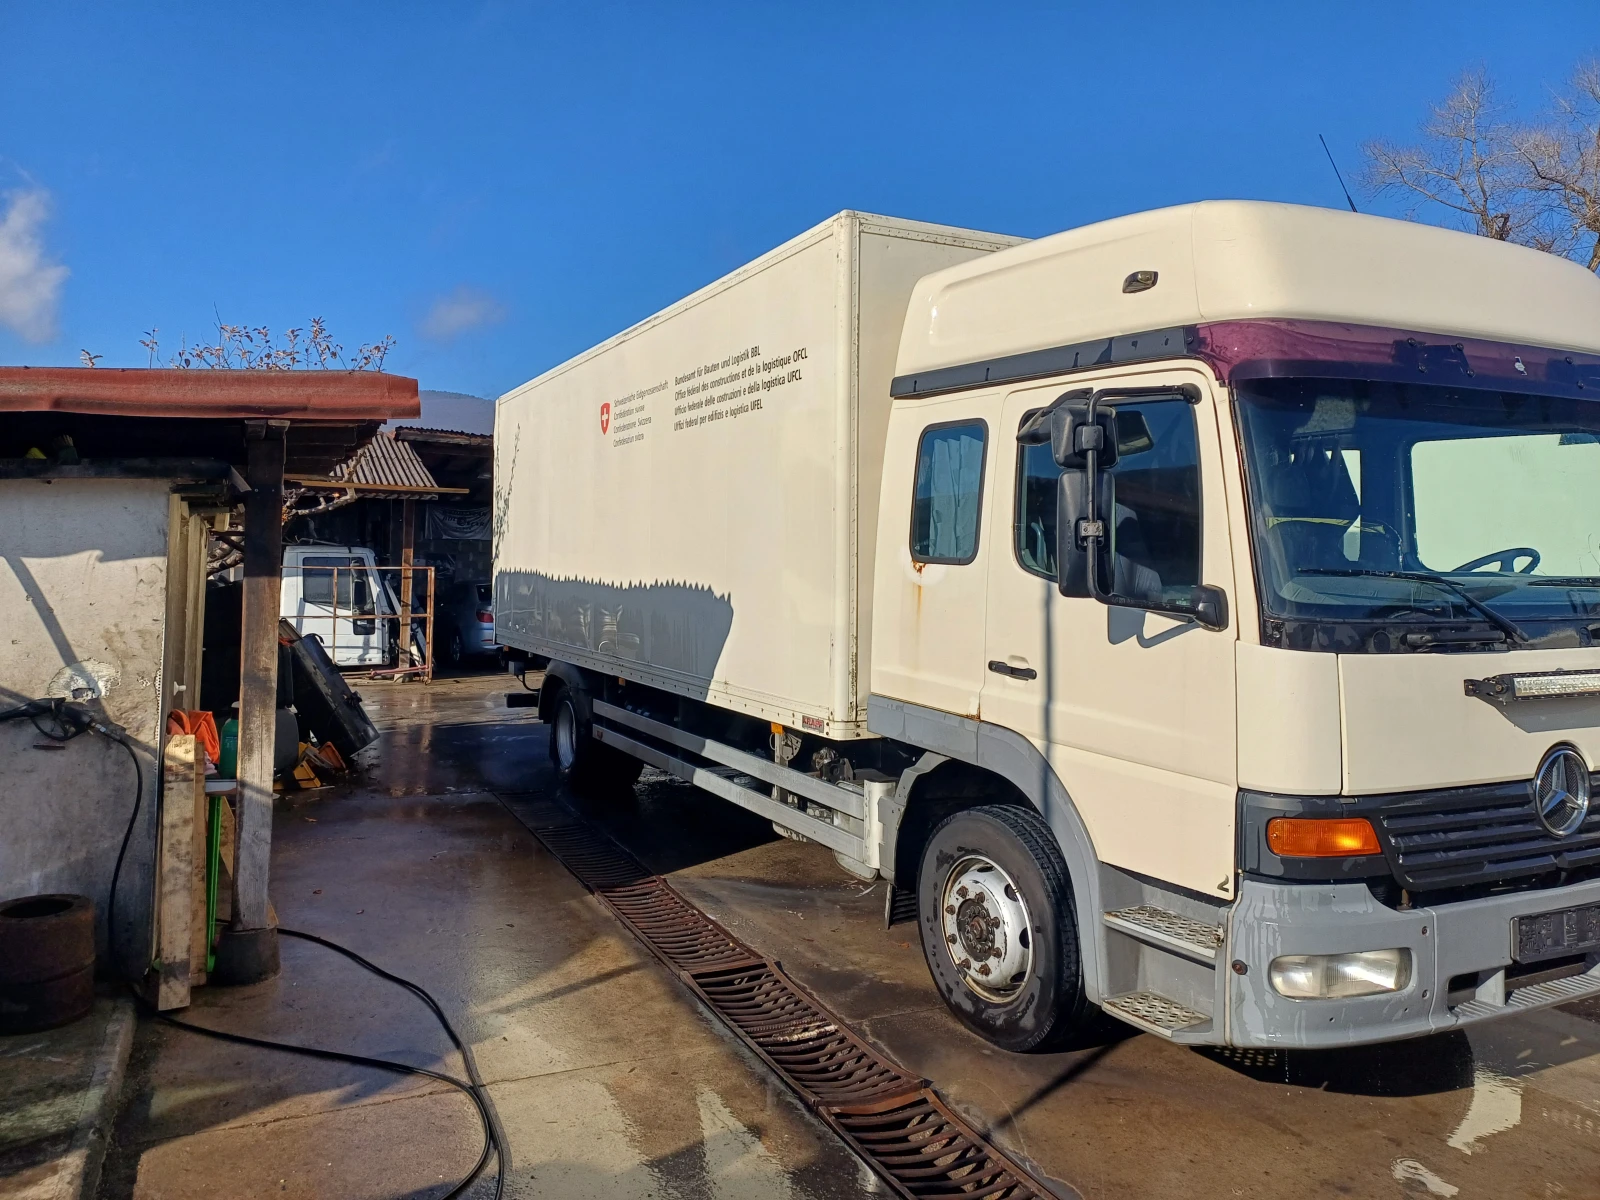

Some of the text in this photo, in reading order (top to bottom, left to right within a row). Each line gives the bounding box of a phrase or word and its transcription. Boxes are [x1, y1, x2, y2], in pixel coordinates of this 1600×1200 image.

[675, 370, 696, 386] Bundesamt
[704, 362, 720, 376] Bauten
[721, 356, 731, 369] und
[732, 349, 750, 367] Logistik
[751, 345, 761, 359] BBL
[675, 389, 686, 401] Office
[710, 372, 741, 389] constructions
[742, 368, 747, 379] et
[748, 364, 755, 377] de
[756, 362, 761, 374] la
[763, 355, 792, 374] logistique
[793, 347, 808, 362] OFCL
[675, 403, 687, 416] Ufficio
[688, 398, 704, 411] federale
[704, 394, 716, 407] delle
[717, 386, 742, 404] costruzioni
[748, 381, 761, 395] della
[762, 377, 786, 392] logistica
[788, 369, 803, 383] UFCL
[685, 414, 699, 428] federal
[730, 403, 749, 419] logistica
[750, 398, 763, 411] UFEL
